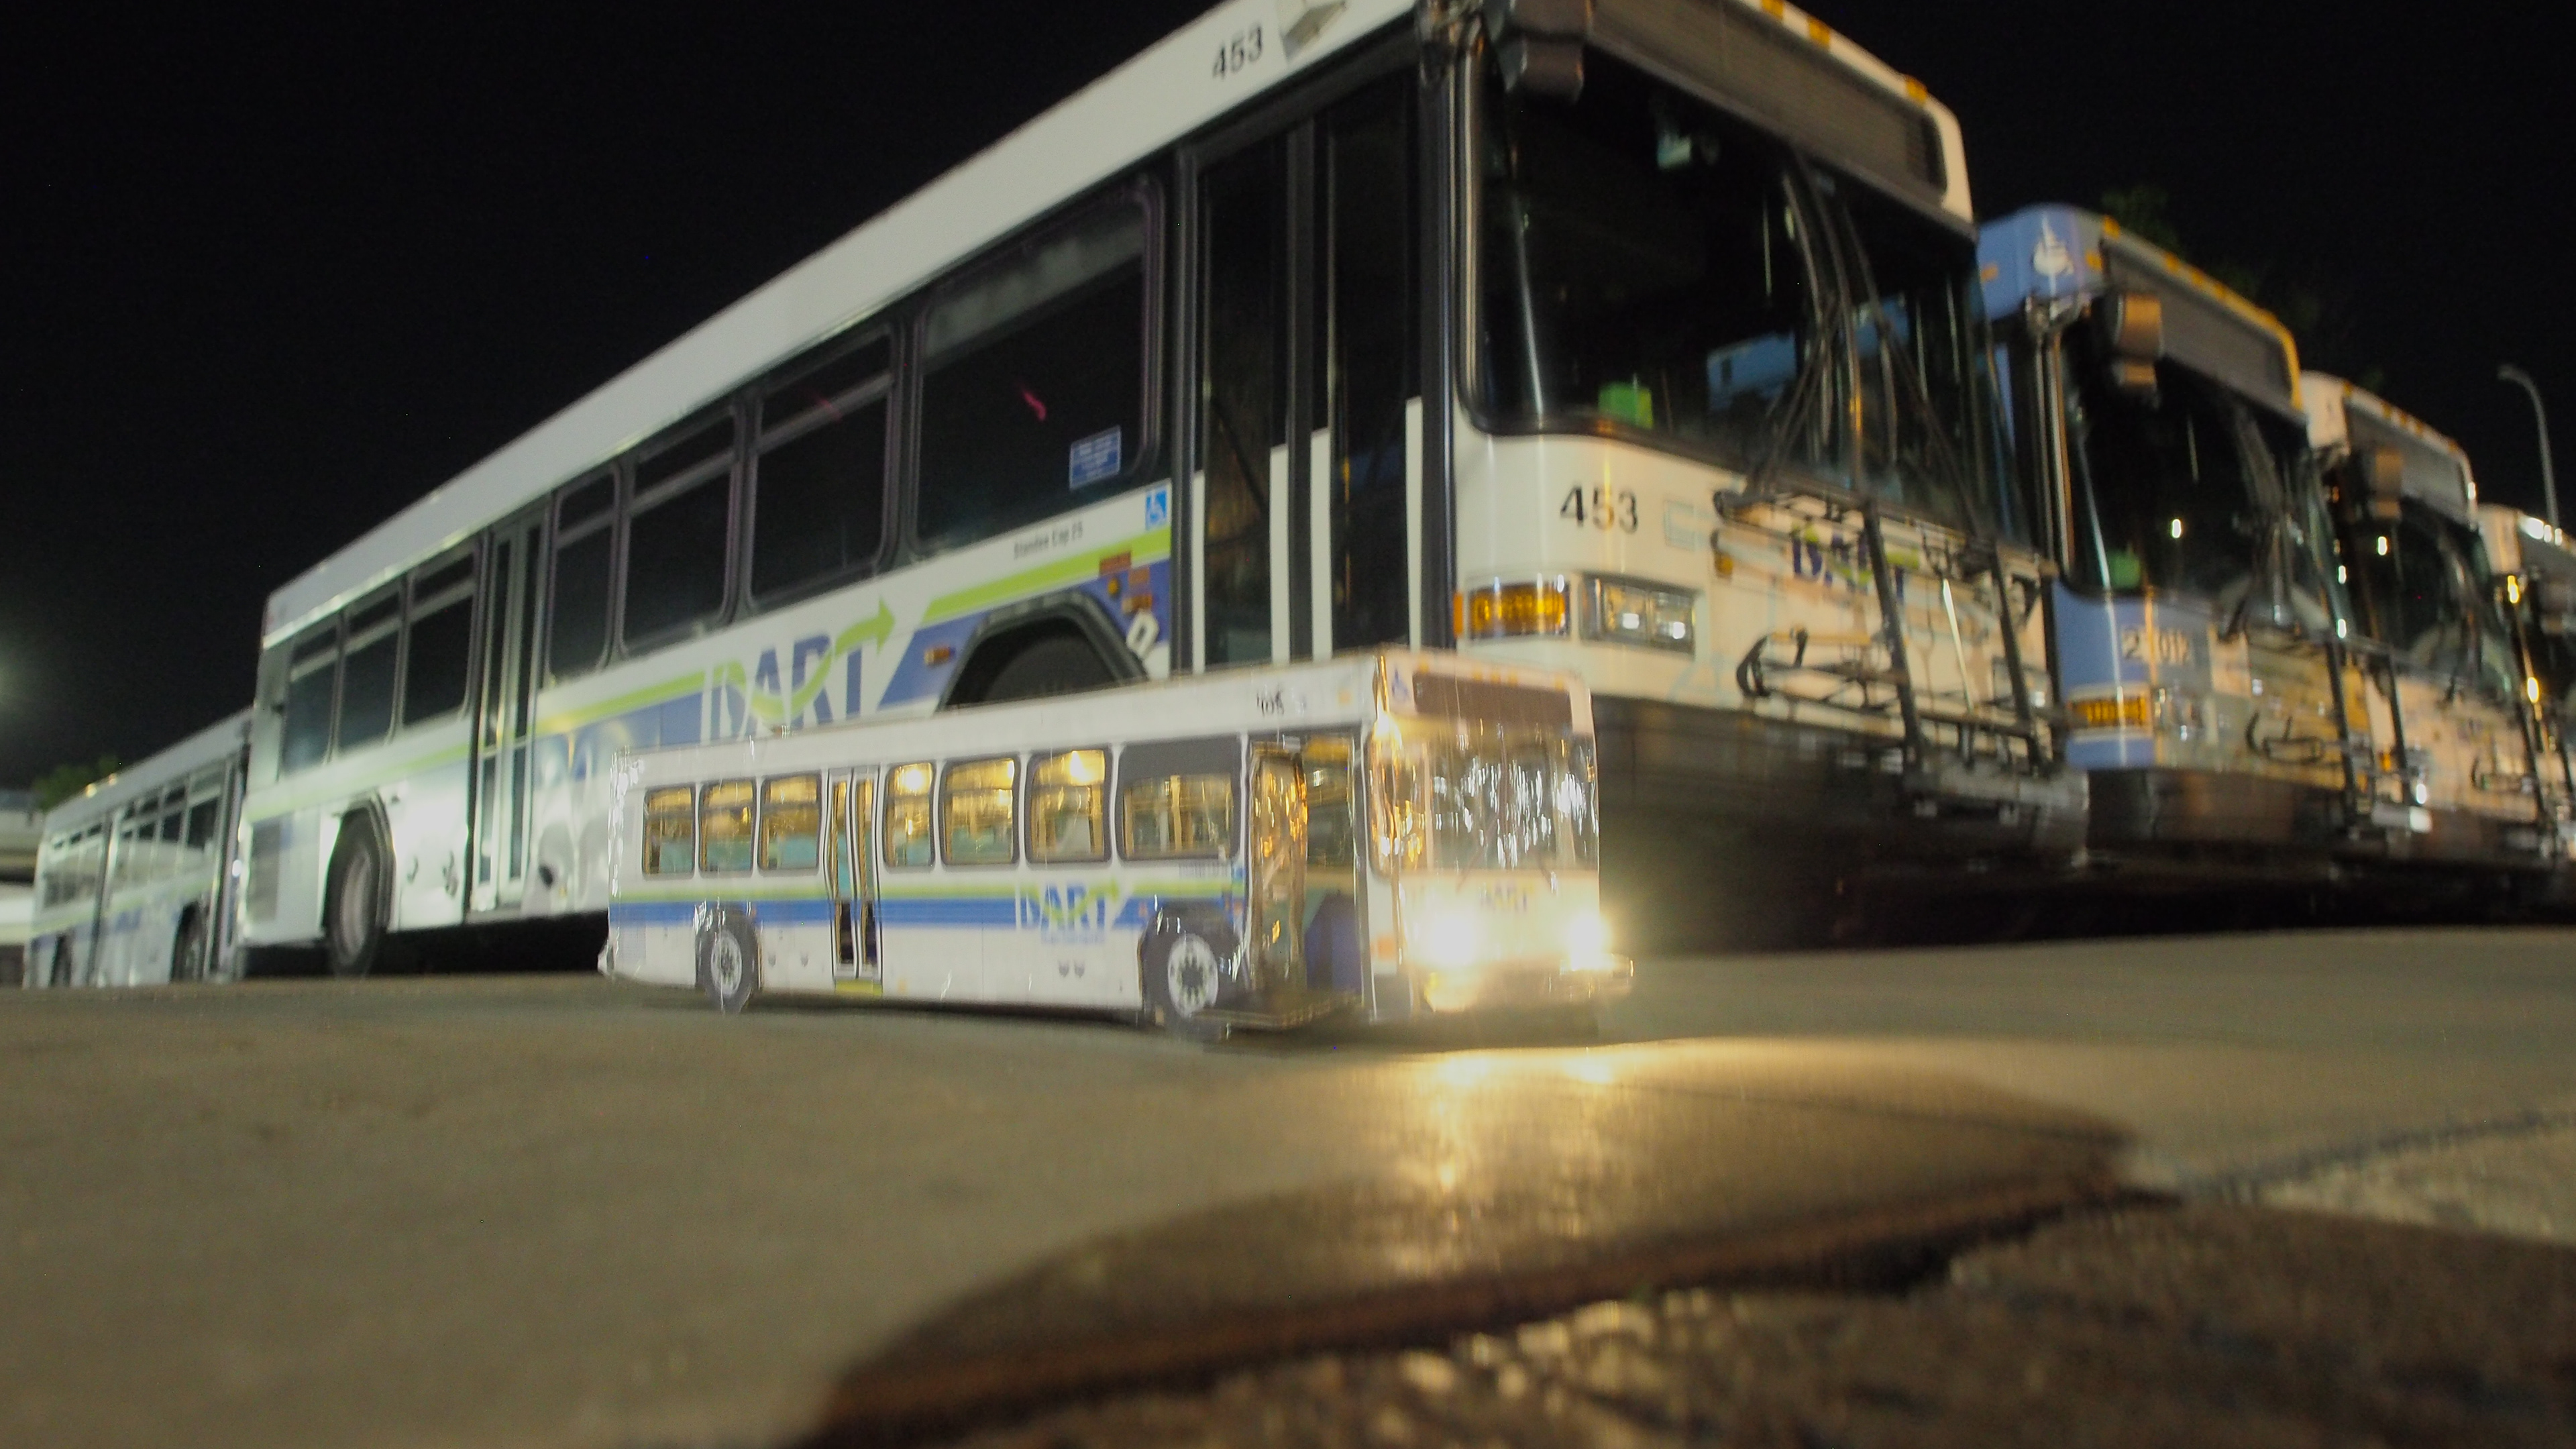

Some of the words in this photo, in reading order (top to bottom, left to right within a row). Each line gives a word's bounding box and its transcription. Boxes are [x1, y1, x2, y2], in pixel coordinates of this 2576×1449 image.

[1212, 23, 1262, 78] 453
[1560, 485, 1639, 533] 453
[708, 608, 890, 741] DART
[1020, 880, 1116, 931] DART
